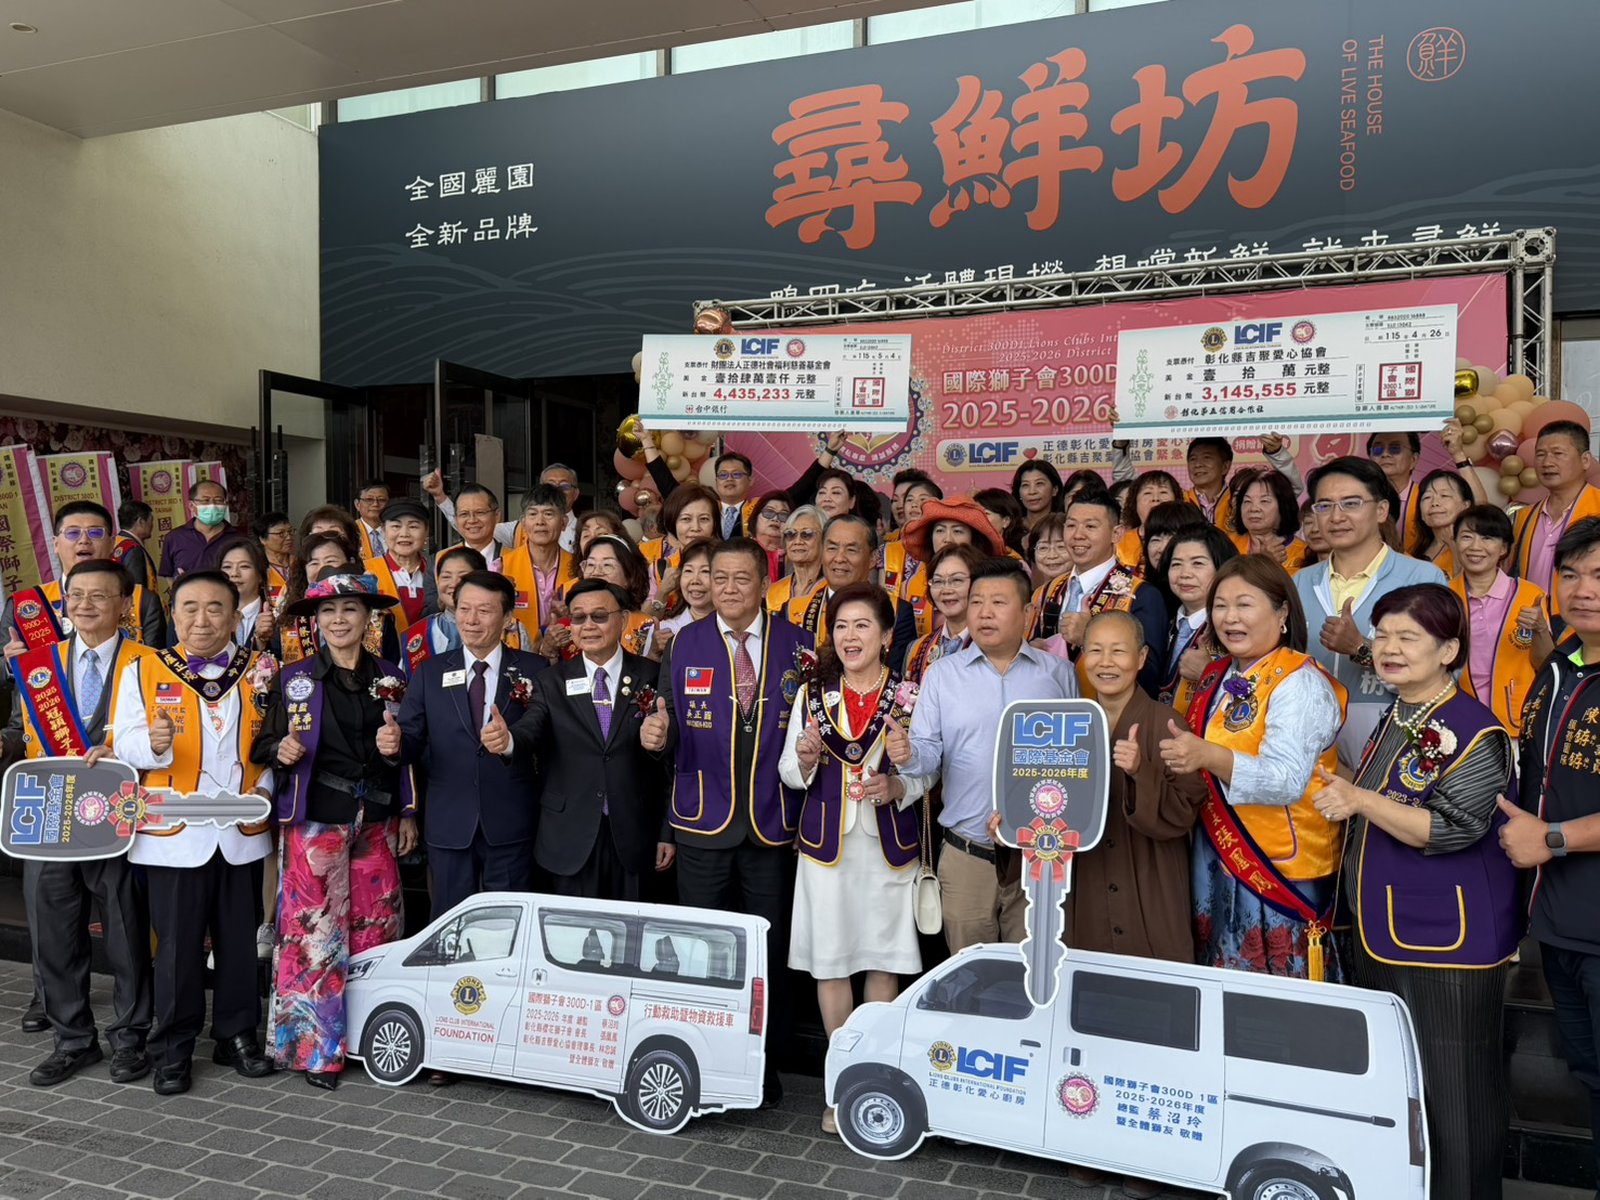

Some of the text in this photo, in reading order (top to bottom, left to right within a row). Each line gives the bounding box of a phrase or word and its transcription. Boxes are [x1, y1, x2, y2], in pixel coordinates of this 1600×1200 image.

[1366, 34, 1384, 136] THE HOUSE
[1339, 39, 1358, 191] OF LIVE SEAFOOD
[765, 23, 1306, 249] 尋鮮坊
[404, 162, 534, 201] 全國麗園
[404, 213, 538, 249] 全新品牌
[1064, 335, 1096, 346] Clubs
[1234, 322, 1283, 345] LCIF
[1430, 329, 1442, 337] 26
[741, 338, 780, 355] LCIF
[1067, 346, 1112, 358] District
[713, 388, 790, 401] 4,435,233
[1202, 382, 1297, 402] 3,145,555
[942, 394, 1113, 429] 2025-2026
[968, 441, 1019, 464] LCIF
[28, 628, 51, 641] 2025
[35, 686, 57, 702] 2025
[38, 695, 61, 712] 2026
[1012, 711, 1092, 747] LCIF
[1012, 748, 1090, 765] 國際基金會
[1012, 767, 1089, 779] 2025-2026年度
[10, 773, 46, 845] LCIF
[61, 774, 76, 843] 2025-2026年度
[433, 1026, 495, 1043] FOUNDATION
[956, 1046, 1029, 1082] LCIF
[1116, 1089, 1206, 1115] 2025-2026年度
